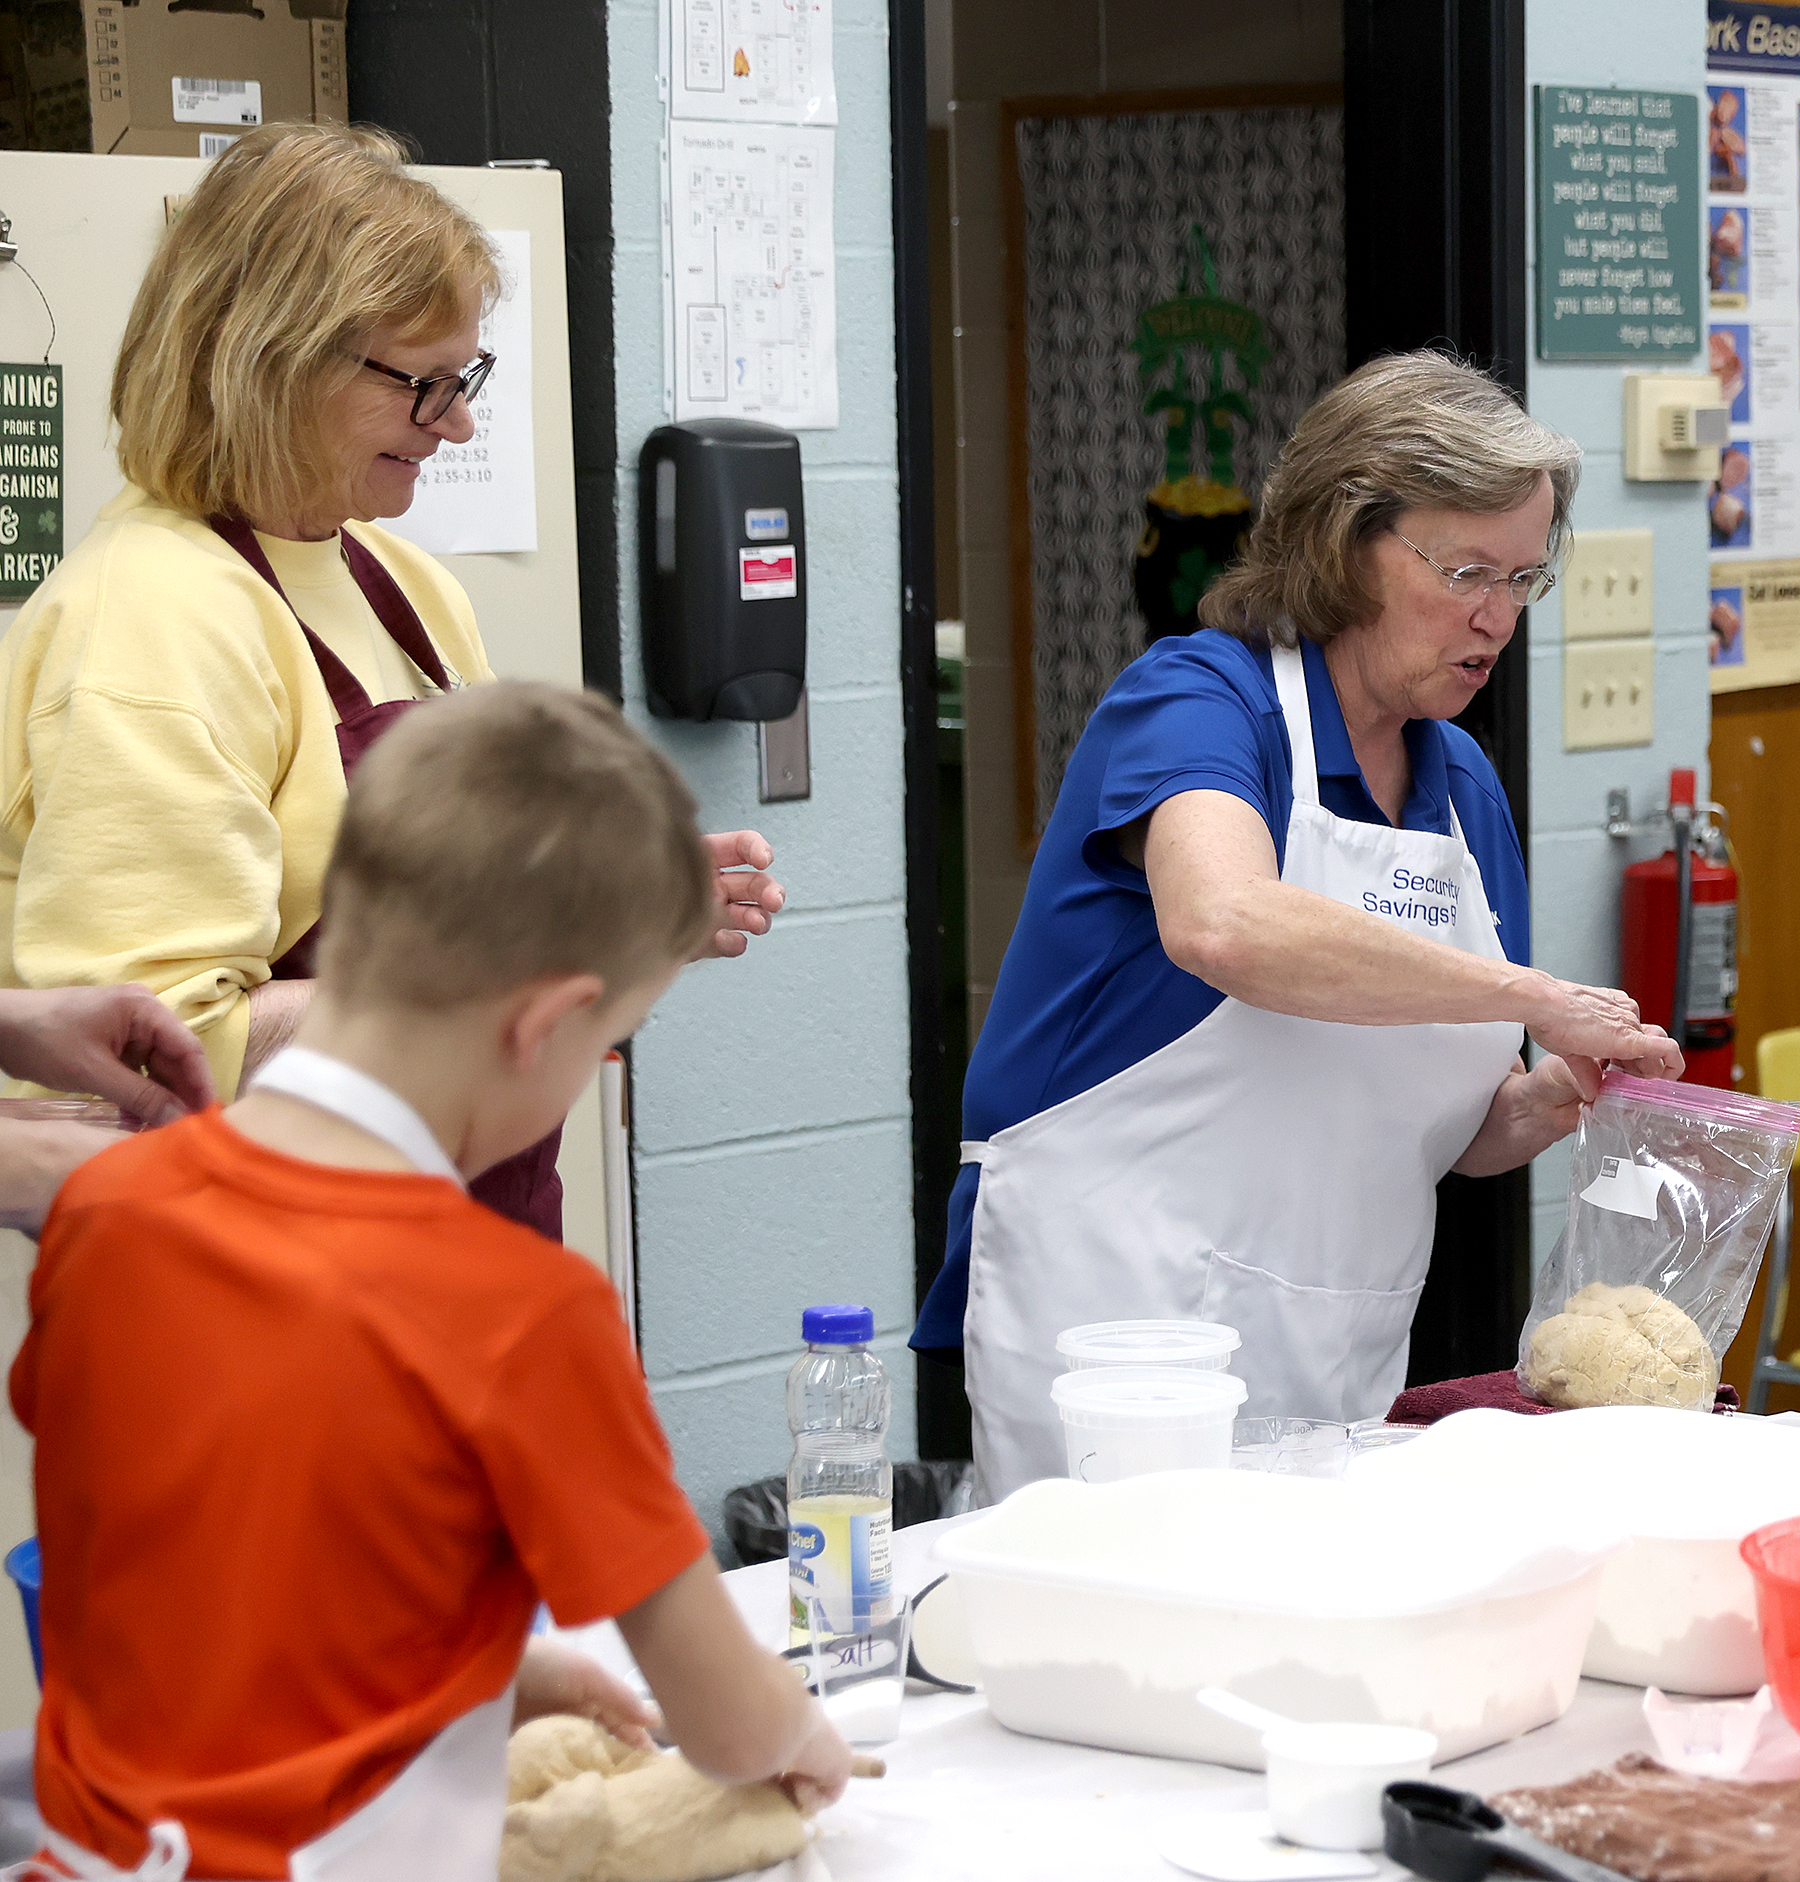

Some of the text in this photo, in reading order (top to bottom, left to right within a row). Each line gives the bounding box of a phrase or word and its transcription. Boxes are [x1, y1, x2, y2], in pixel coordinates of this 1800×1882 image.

[1558, 90, 1674, 118] I've learned that
[1553, 120, 1679, 154] people will forget
[1570, 149, 1668, 177] what you said
[1553, 178, 1679, 209] people will forget
[1574, 206, 1608, 231] what
[1610, 213, 1636, 236] you
[1564, 234, 1669, 262] but people will
[1558, 264, 1674, 293] never forget how
[1554, 295, 1580, 320] you
[1582, 291, 1616, 315] made
[1618, 294, 1650, 315] them
[0, 374, 58, 408] NING
[3, 419, 51, 436] PRONE TO
[0, 443, 59, 468] NIGANS
[0, 504, 20, 546] &
[0, 553, 59, 581] RKEY!
[1393, 868, 1461, 905] Security
[1362, 891, 1450, 927] Savings
[791, 1530, 816, 1550] Chef
[825, 1634, 883, 1668] Salt
